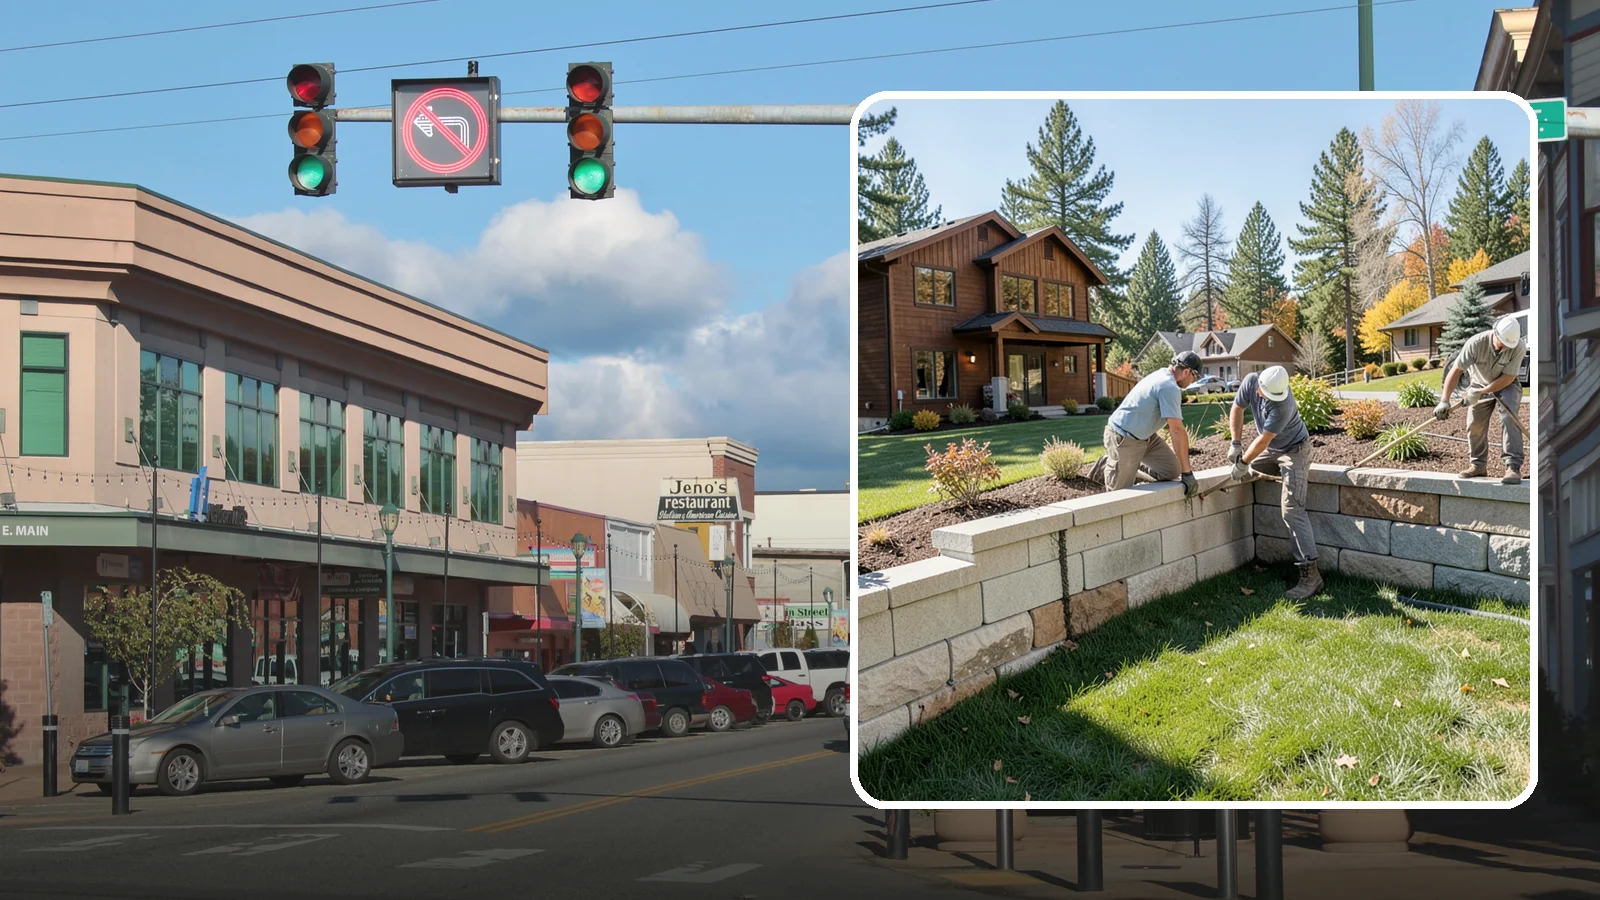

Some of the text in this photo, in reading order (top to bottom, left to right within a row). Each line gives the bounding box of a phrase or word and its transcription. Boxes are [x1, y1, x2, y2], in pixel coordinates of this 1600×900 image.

[670, 480, 727, 494] Jeno's
[665, 496, 731, 509] restaurant
[658, 509, 681, 519] Italian
[686, 509, 715, 519] American
[715, 509, 737, 519] Cuisine
[2, 525, 49, 536] E. MAIN
[797, 608, 828, 616] Street
